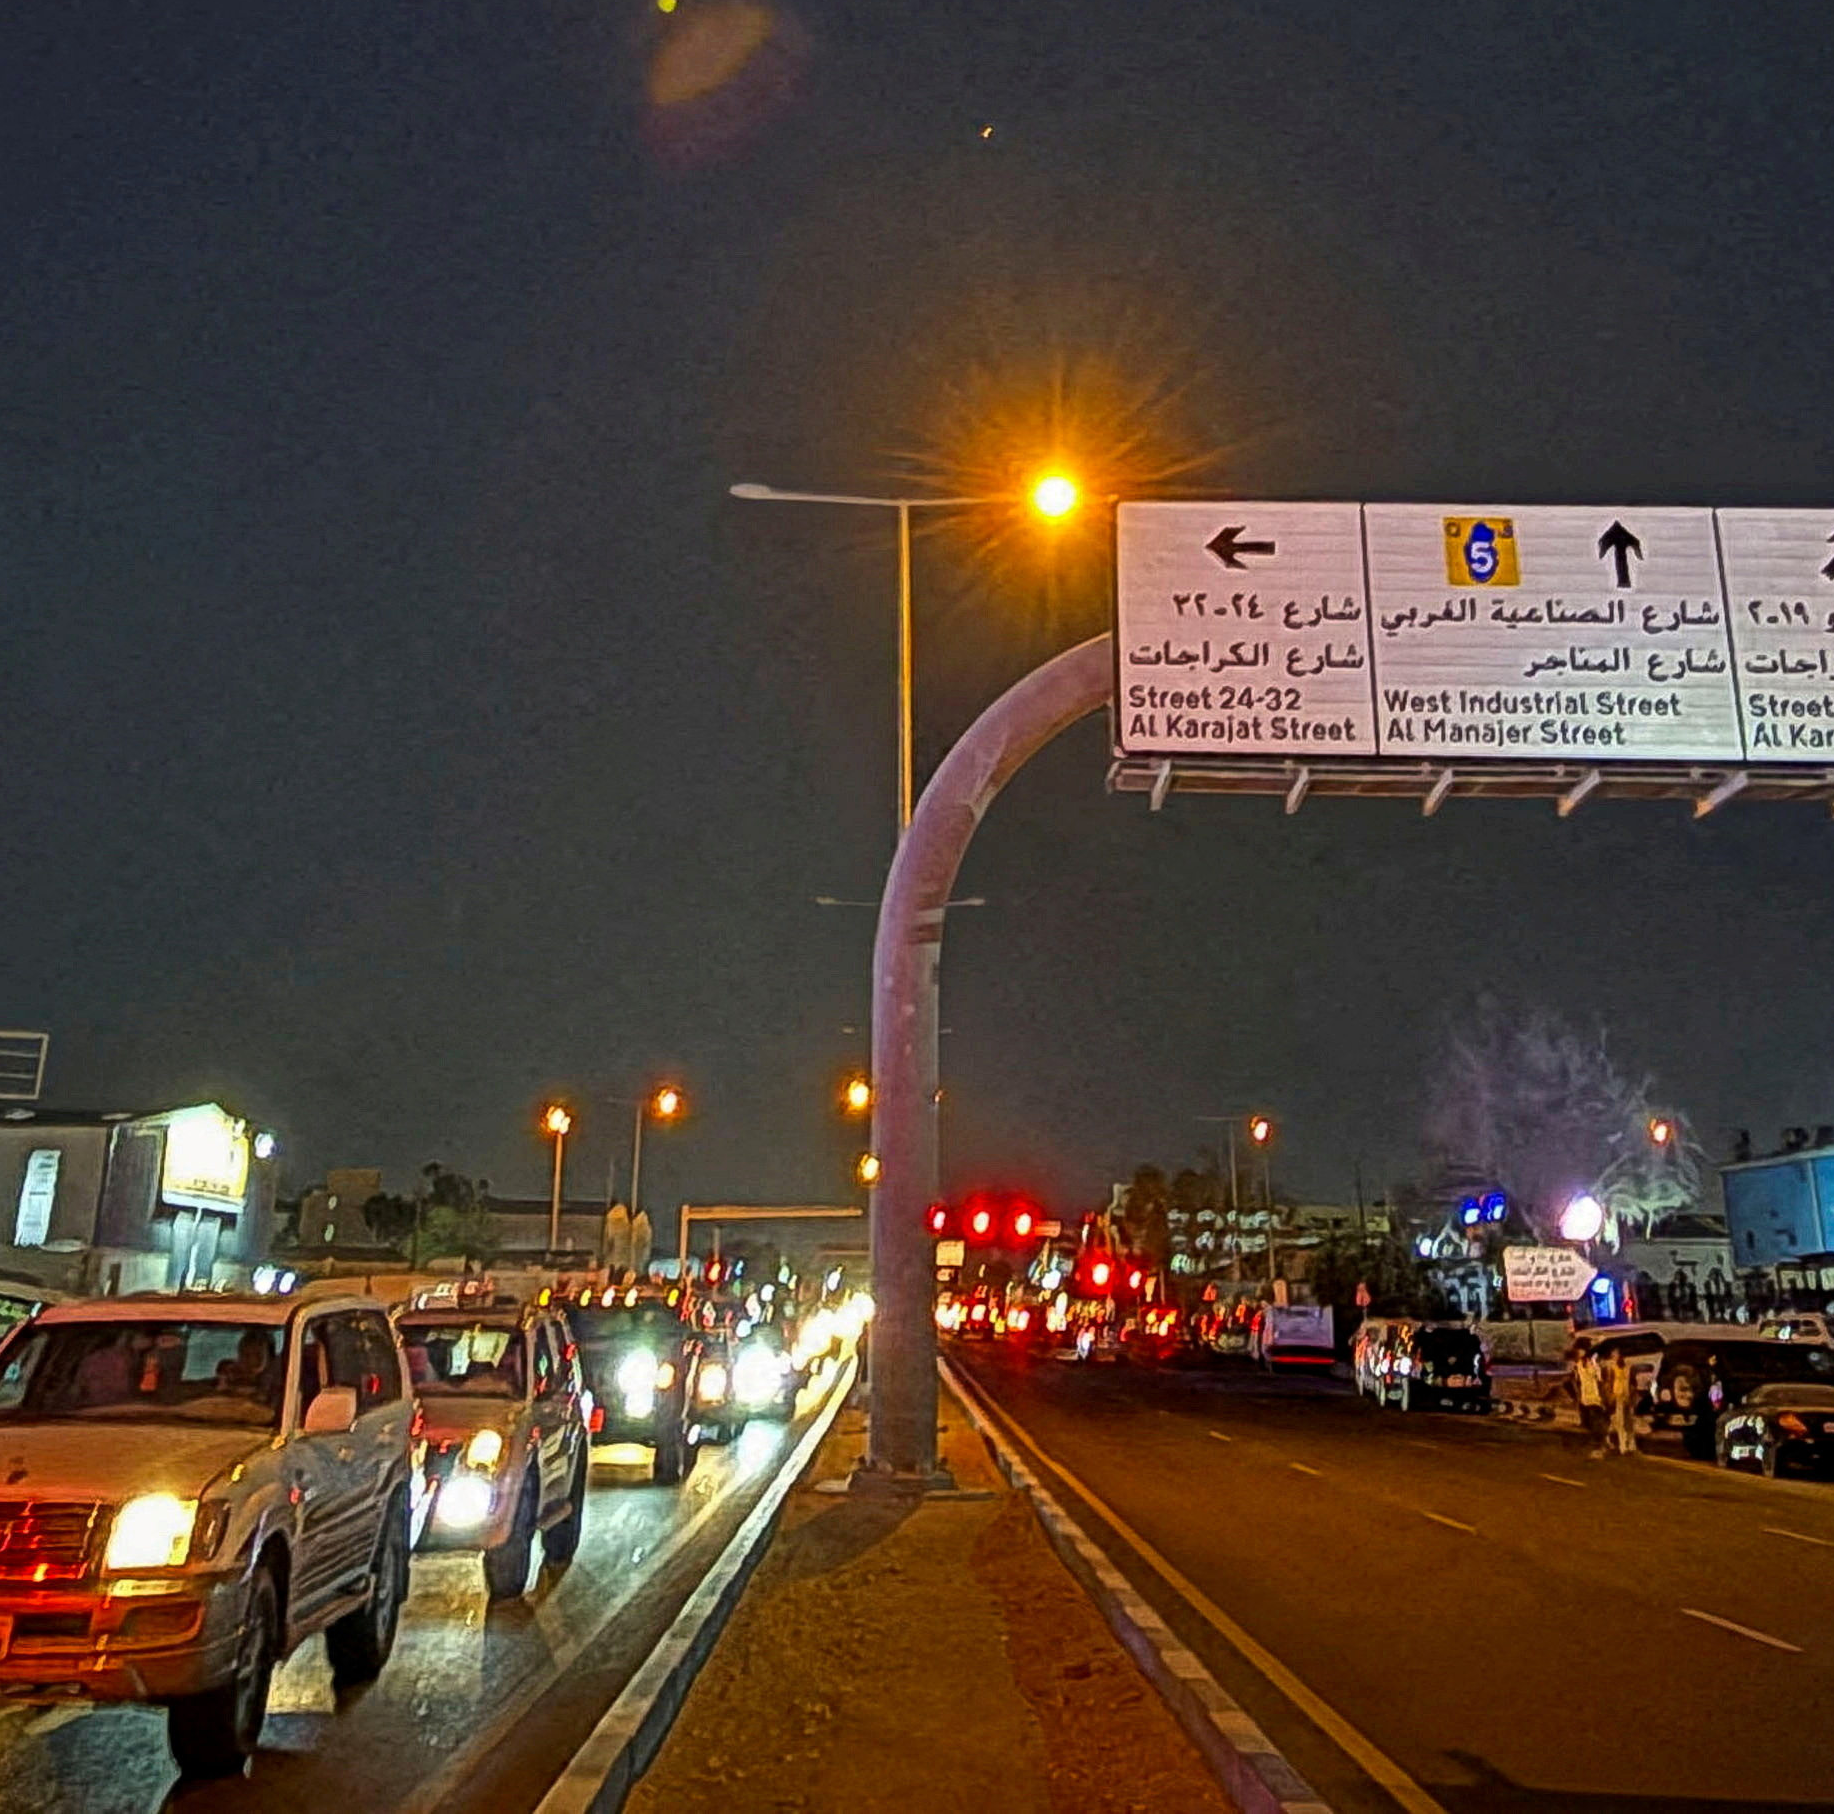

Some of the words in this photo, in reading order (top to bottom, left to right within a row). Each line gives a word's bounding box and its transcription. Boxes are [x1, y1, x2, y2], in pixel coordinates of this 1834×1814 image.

[1470, 541, 1494, 573] 5
[1283, 595, 1362, 629] شارع
[1380, 597, 1477, 636] الغربي
[1491, 598, 1624, 629] الصناعية
[1642, 599, 1720, 634] شارع
[1129, 640, 1269, 672] الكراجات
[1285, 643, 1364, 677] شارع
[1647, 648, 1727, 682] شارع
[1129, 685, 1213, 710] Street
[1219, 686, 1302, 711] 24-32
[1383, 689, 1452, 714] West
[1459, 689, 1590, 715] Industrial
[1597, 691, 1682, 716] Street
[1129, 714, 1159, 737] Al
[1166, 713, 1262, 743] Karajat
[1270, 716, 1356, 741] Street
[1387, 717, 1416, 742] Al
[1424, 717, 1533, 747] Manajer
[1540, 718, 1627, 746] Street
[1753, 722, 1782, 749] Al
